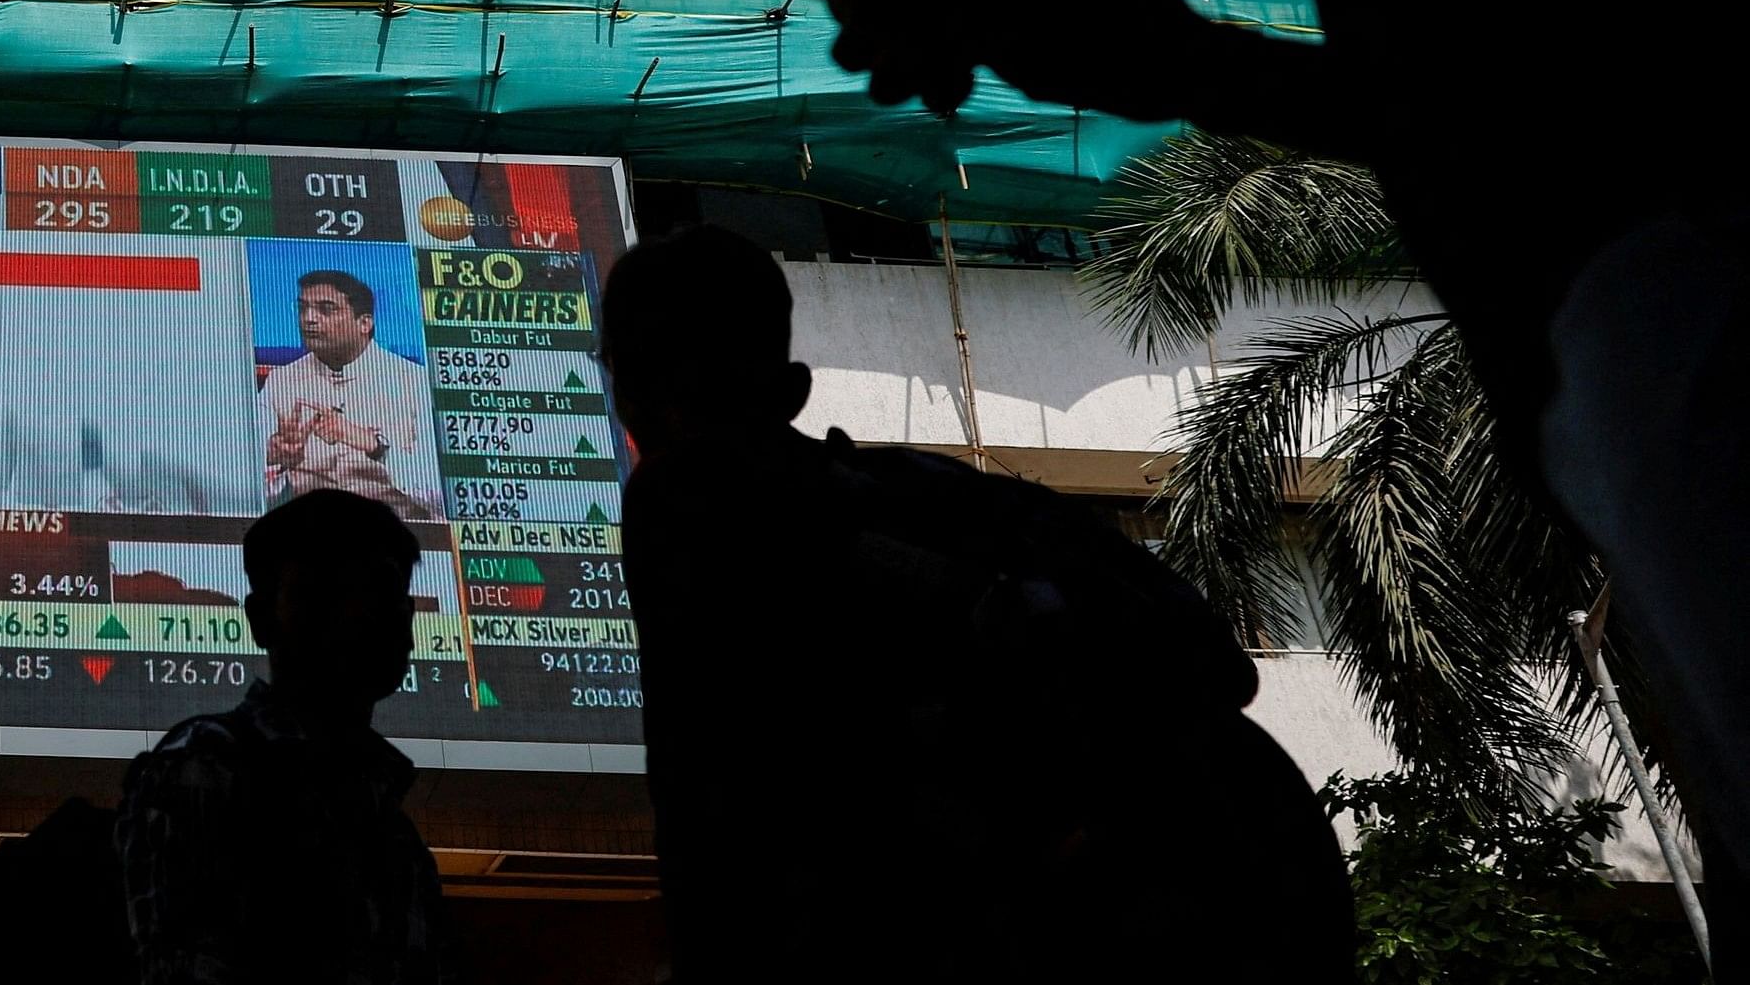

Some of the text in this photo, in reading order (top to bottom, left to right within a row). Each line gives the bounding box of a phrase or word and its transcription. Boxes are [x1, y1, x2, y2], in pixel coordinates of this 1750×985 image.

[37, 164, 107, 191] NDA
[150, 167, 258, 195] I.N.D.I.A.
[305, 172, 368, 199] OTH
[33, 200, 110, 229] 295
[169, 204, 243, 232] 219
[314, 208, 365, 236] 29
[430, 251, 524, 290] F&O
[433, 290, 580, 324] GAINERS
[470, 328, 552, 346] Dabur Fut
[437, 350, 510, 369] 568.20
[440, 369, 502, 387] 3.46%
[470, 391, 572, 411] Colgate Fut
[446, 415, 534, 434] 2777.90
[449, 434, 511, 452] 2.67%
[486, 458, 577, 477] Marico Fut
[454, 481, 529, 501] 610.05
[457, 501, 522, 519] 2.04%
[460, 524, 608, 549] Adv Dec NSE
[467, 558, 507, 579] ADV
[9, 572, 100, 598] 3.44%
[469, 584, 512, 607] DEC
[569, 587, 632, 610] 2014
[158, 615, 242, 643] 71.10
[471, 619, 635, 645] MCX Silver Jul
[144, 658, 245, 686] 126.70
